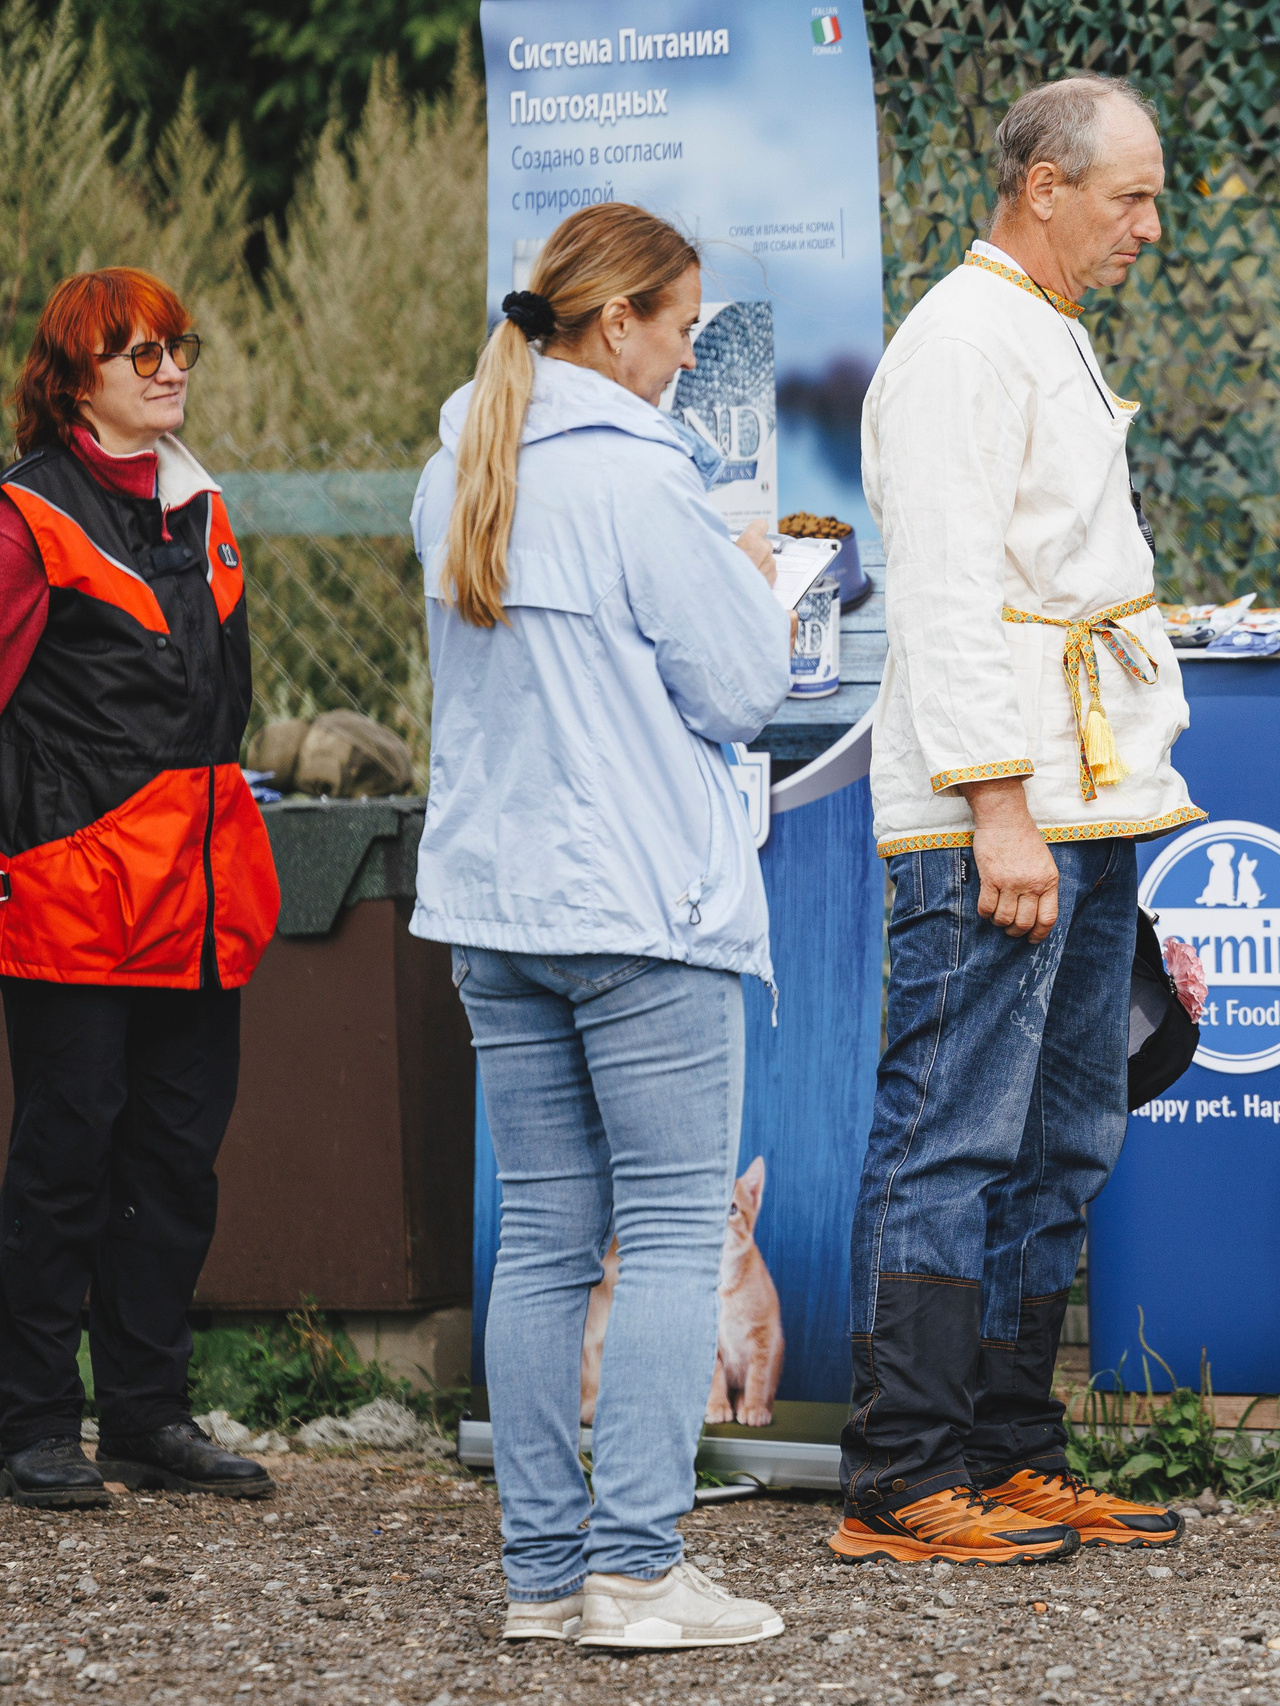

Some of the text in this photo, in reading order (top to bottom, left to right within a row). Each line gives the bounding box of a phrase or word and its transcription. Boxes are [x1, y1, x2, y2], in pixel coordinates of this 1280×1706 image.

[508, 28, 730, 71] Система Питания
[509, 88, 668, 126] Плотоядных
[511, 140, 683, 173] Создано в согласии
[512, 181, 614, 215] с природой
[729, 221, 835, 237] СУХИЕ И ВЛАЖНЫЕ КОРМА
[753, 239, 836, 253] ДЛЯ СОБАК И КОШЕК
[719, 467, 753, 480] CEAN
[1199, 1001, 1220, 1027] et
[1131, 1099, 1190, 1124] appy
[1196, 1095, 1237, 1123] pet.
